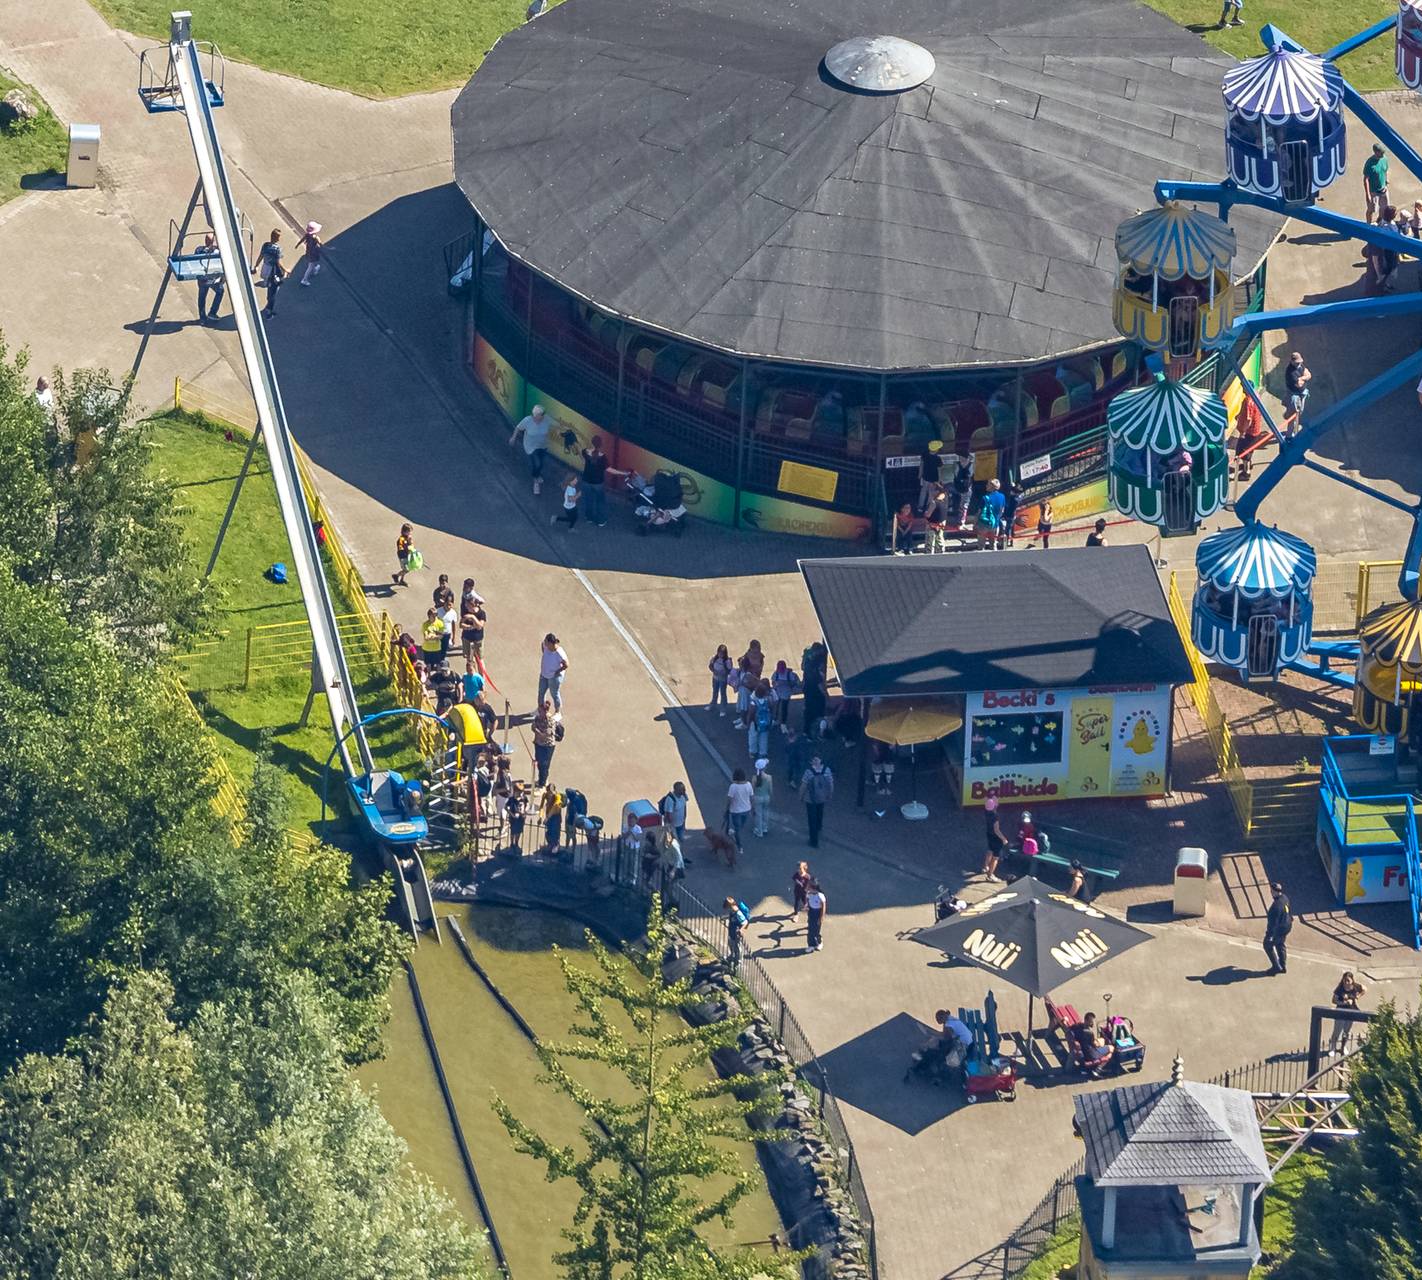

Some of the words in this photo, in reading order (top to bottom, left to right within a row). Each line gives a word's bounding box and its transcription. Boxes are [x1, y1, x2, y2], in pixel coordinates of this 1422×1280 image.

[1075, 711, 1110, 731] Super
[1080, 726, 1105, 745] Ball
[971, 777, 1058, 799] Ballbude
[963, 929, 1021, 970] Nuii
[1050, 928, 1109, 969] Nuii
